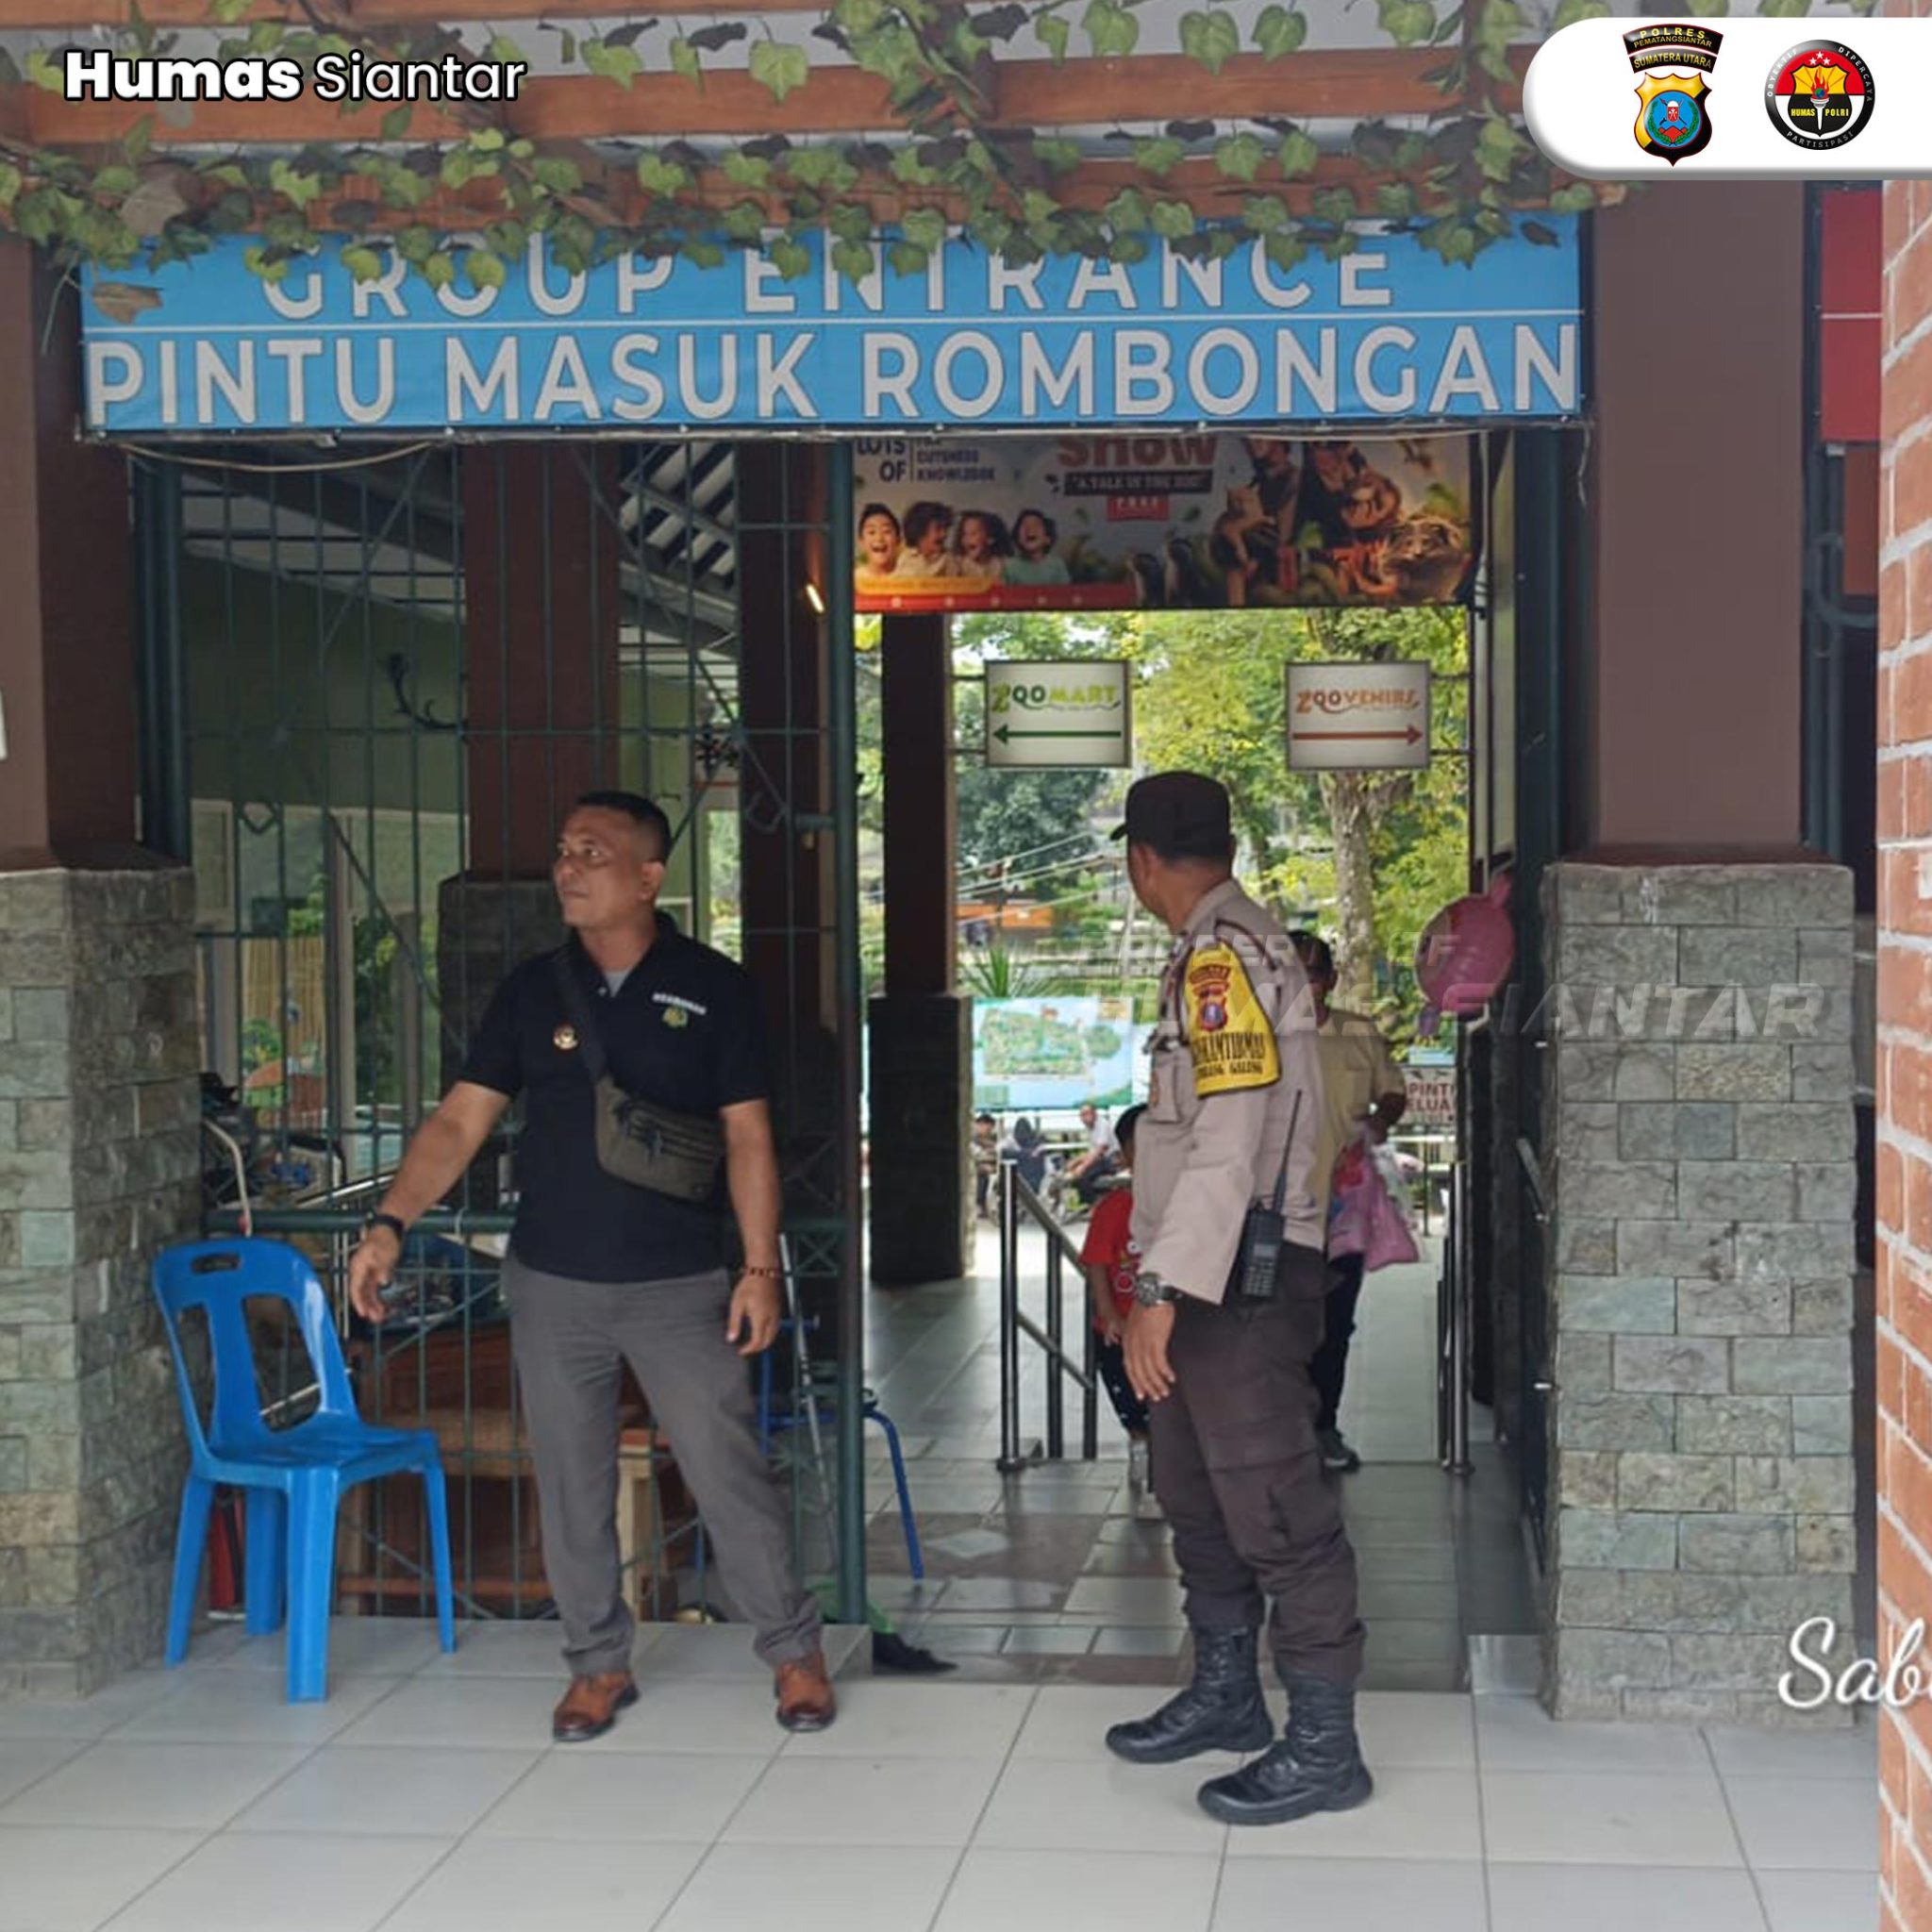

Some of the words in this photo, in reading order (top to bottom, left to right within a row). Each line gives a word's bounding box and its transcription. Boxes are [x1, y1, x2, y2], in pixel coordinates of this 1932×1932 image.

[88, 337, 394, 425] PINTU
[445, 333, 817, 422] MASUK
[862, 324, 1577, 417] ROMBONGAN
[879, 460, 907, 482] OF
